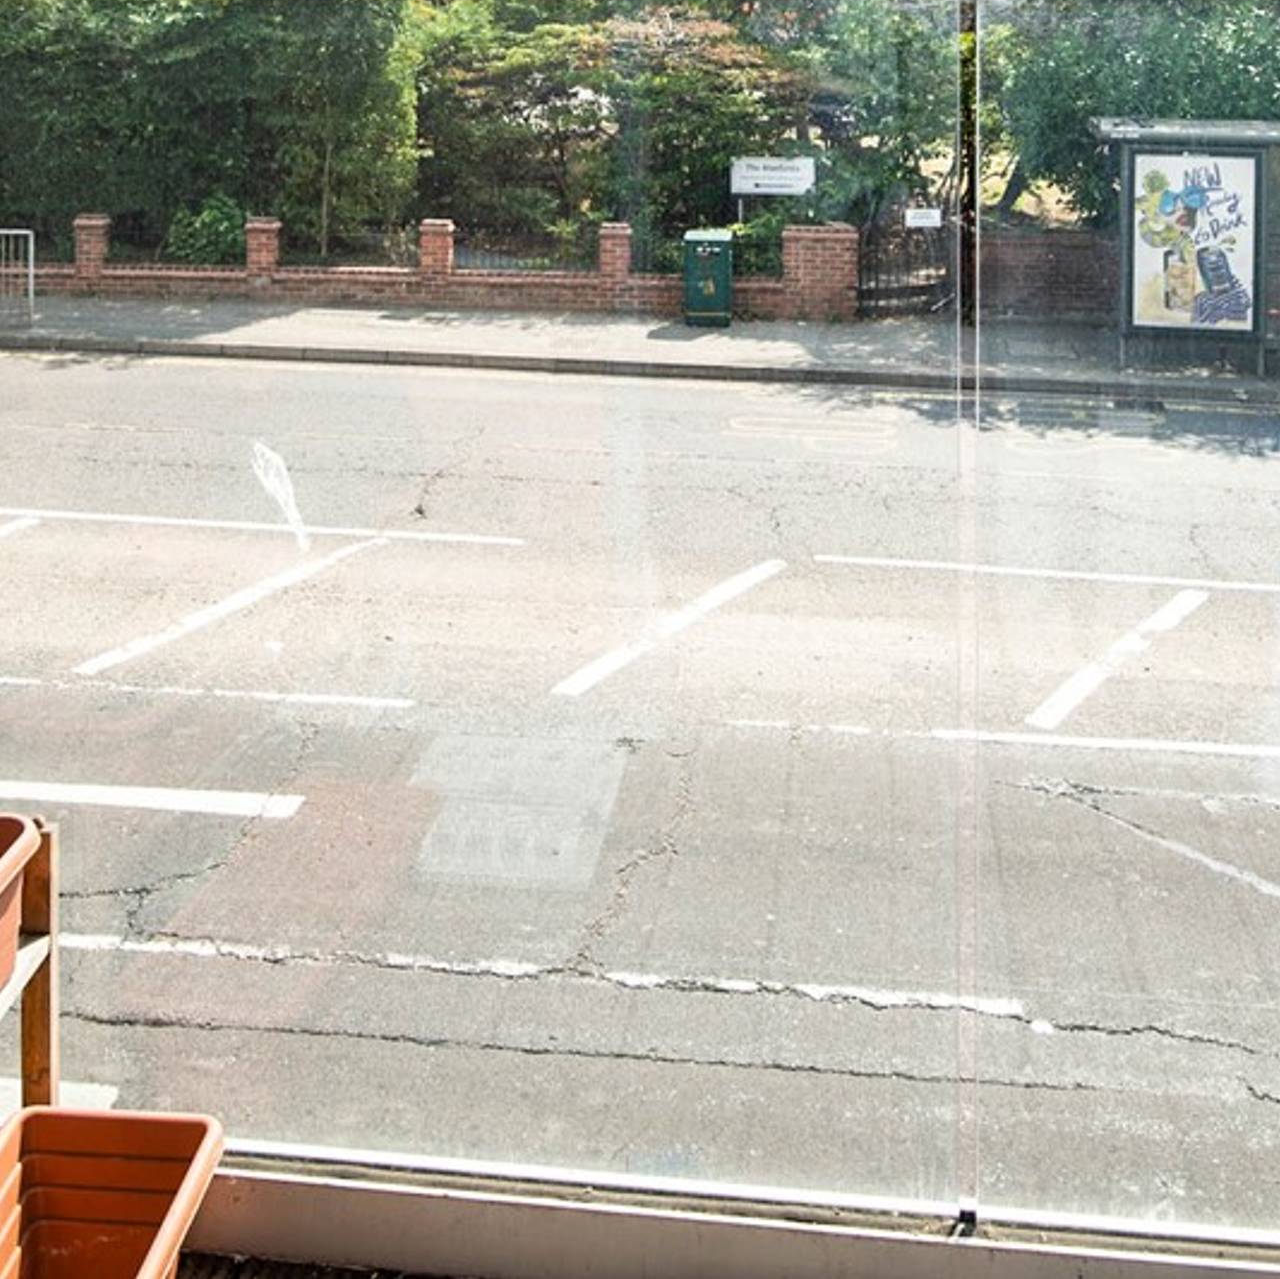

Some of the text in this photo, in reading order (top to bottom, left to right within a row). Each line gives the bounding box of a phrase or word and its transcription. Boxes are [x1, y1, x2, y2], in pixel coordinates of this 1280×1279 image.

[1183, 162, 1222, 188] NEW
[1195, 215, 1248, 245] to Drink
